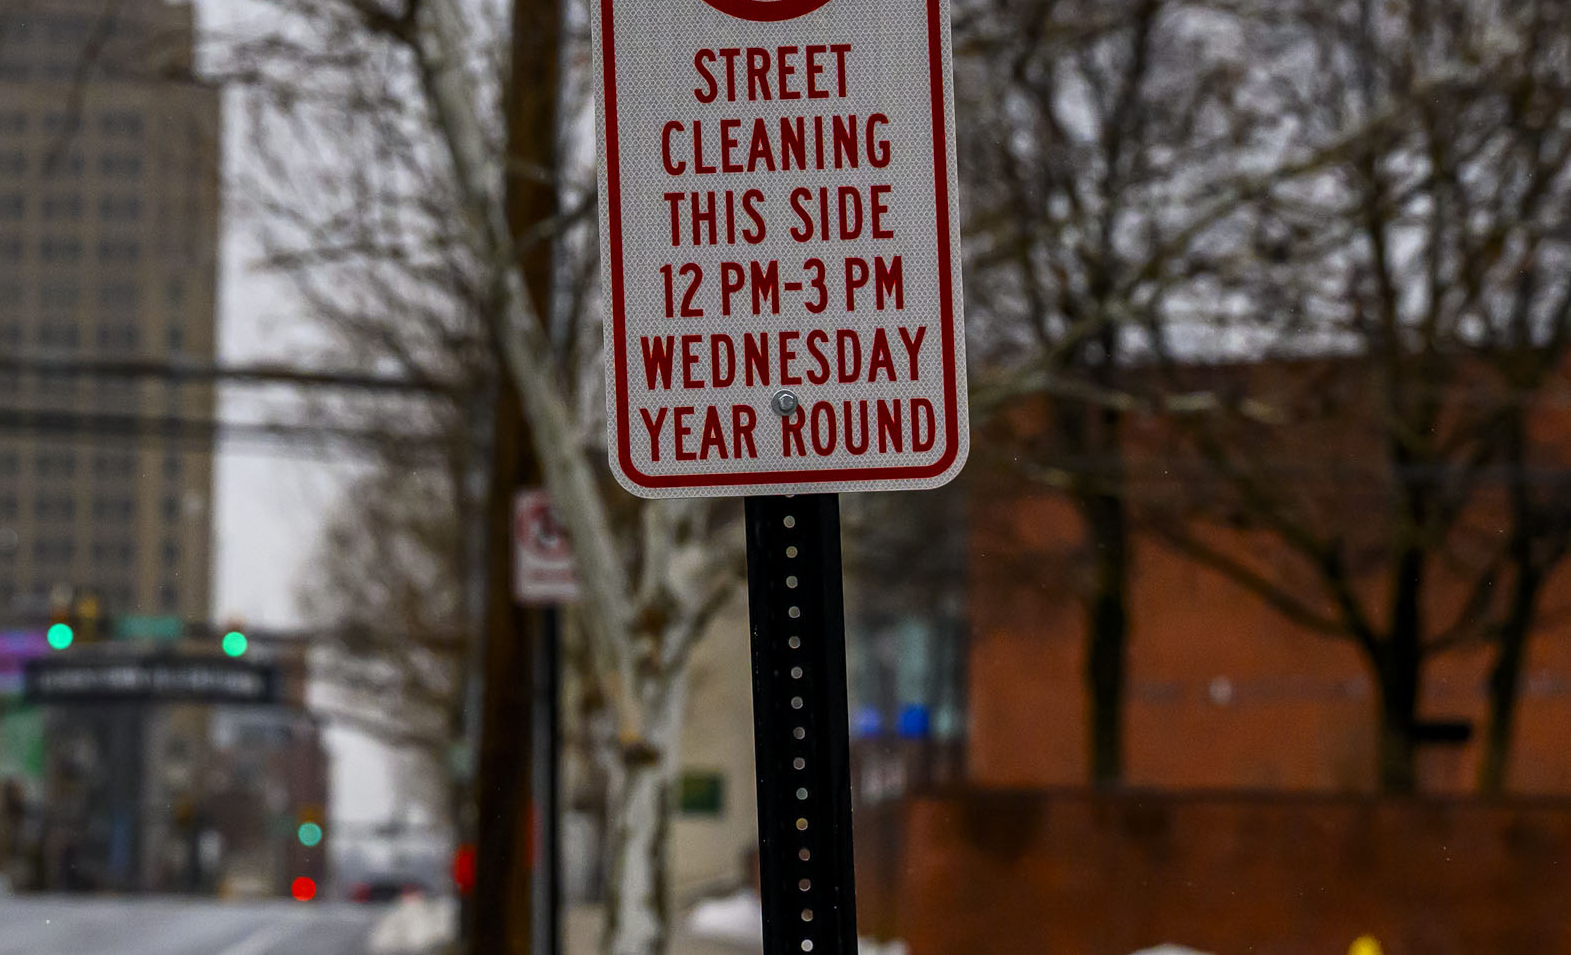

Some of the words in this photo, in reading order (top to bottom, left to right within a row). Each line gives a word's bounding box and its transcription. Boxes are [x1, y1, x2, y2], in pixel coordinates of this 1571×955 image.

[693, 44, 852, 104] STREET
[661, 113, 891, 176] CLEANING
[664, 188, 766, 247] THIS
[790, 185, 894, 243] SIDE
[659, 262, 704, 318] 12
[844, 255, 904, 312] PM
[640, 326, 927, 391] WEDNESDAY
[640, 405, 758, 462] YEAR
[781, 397, 936, 457] ROUND
